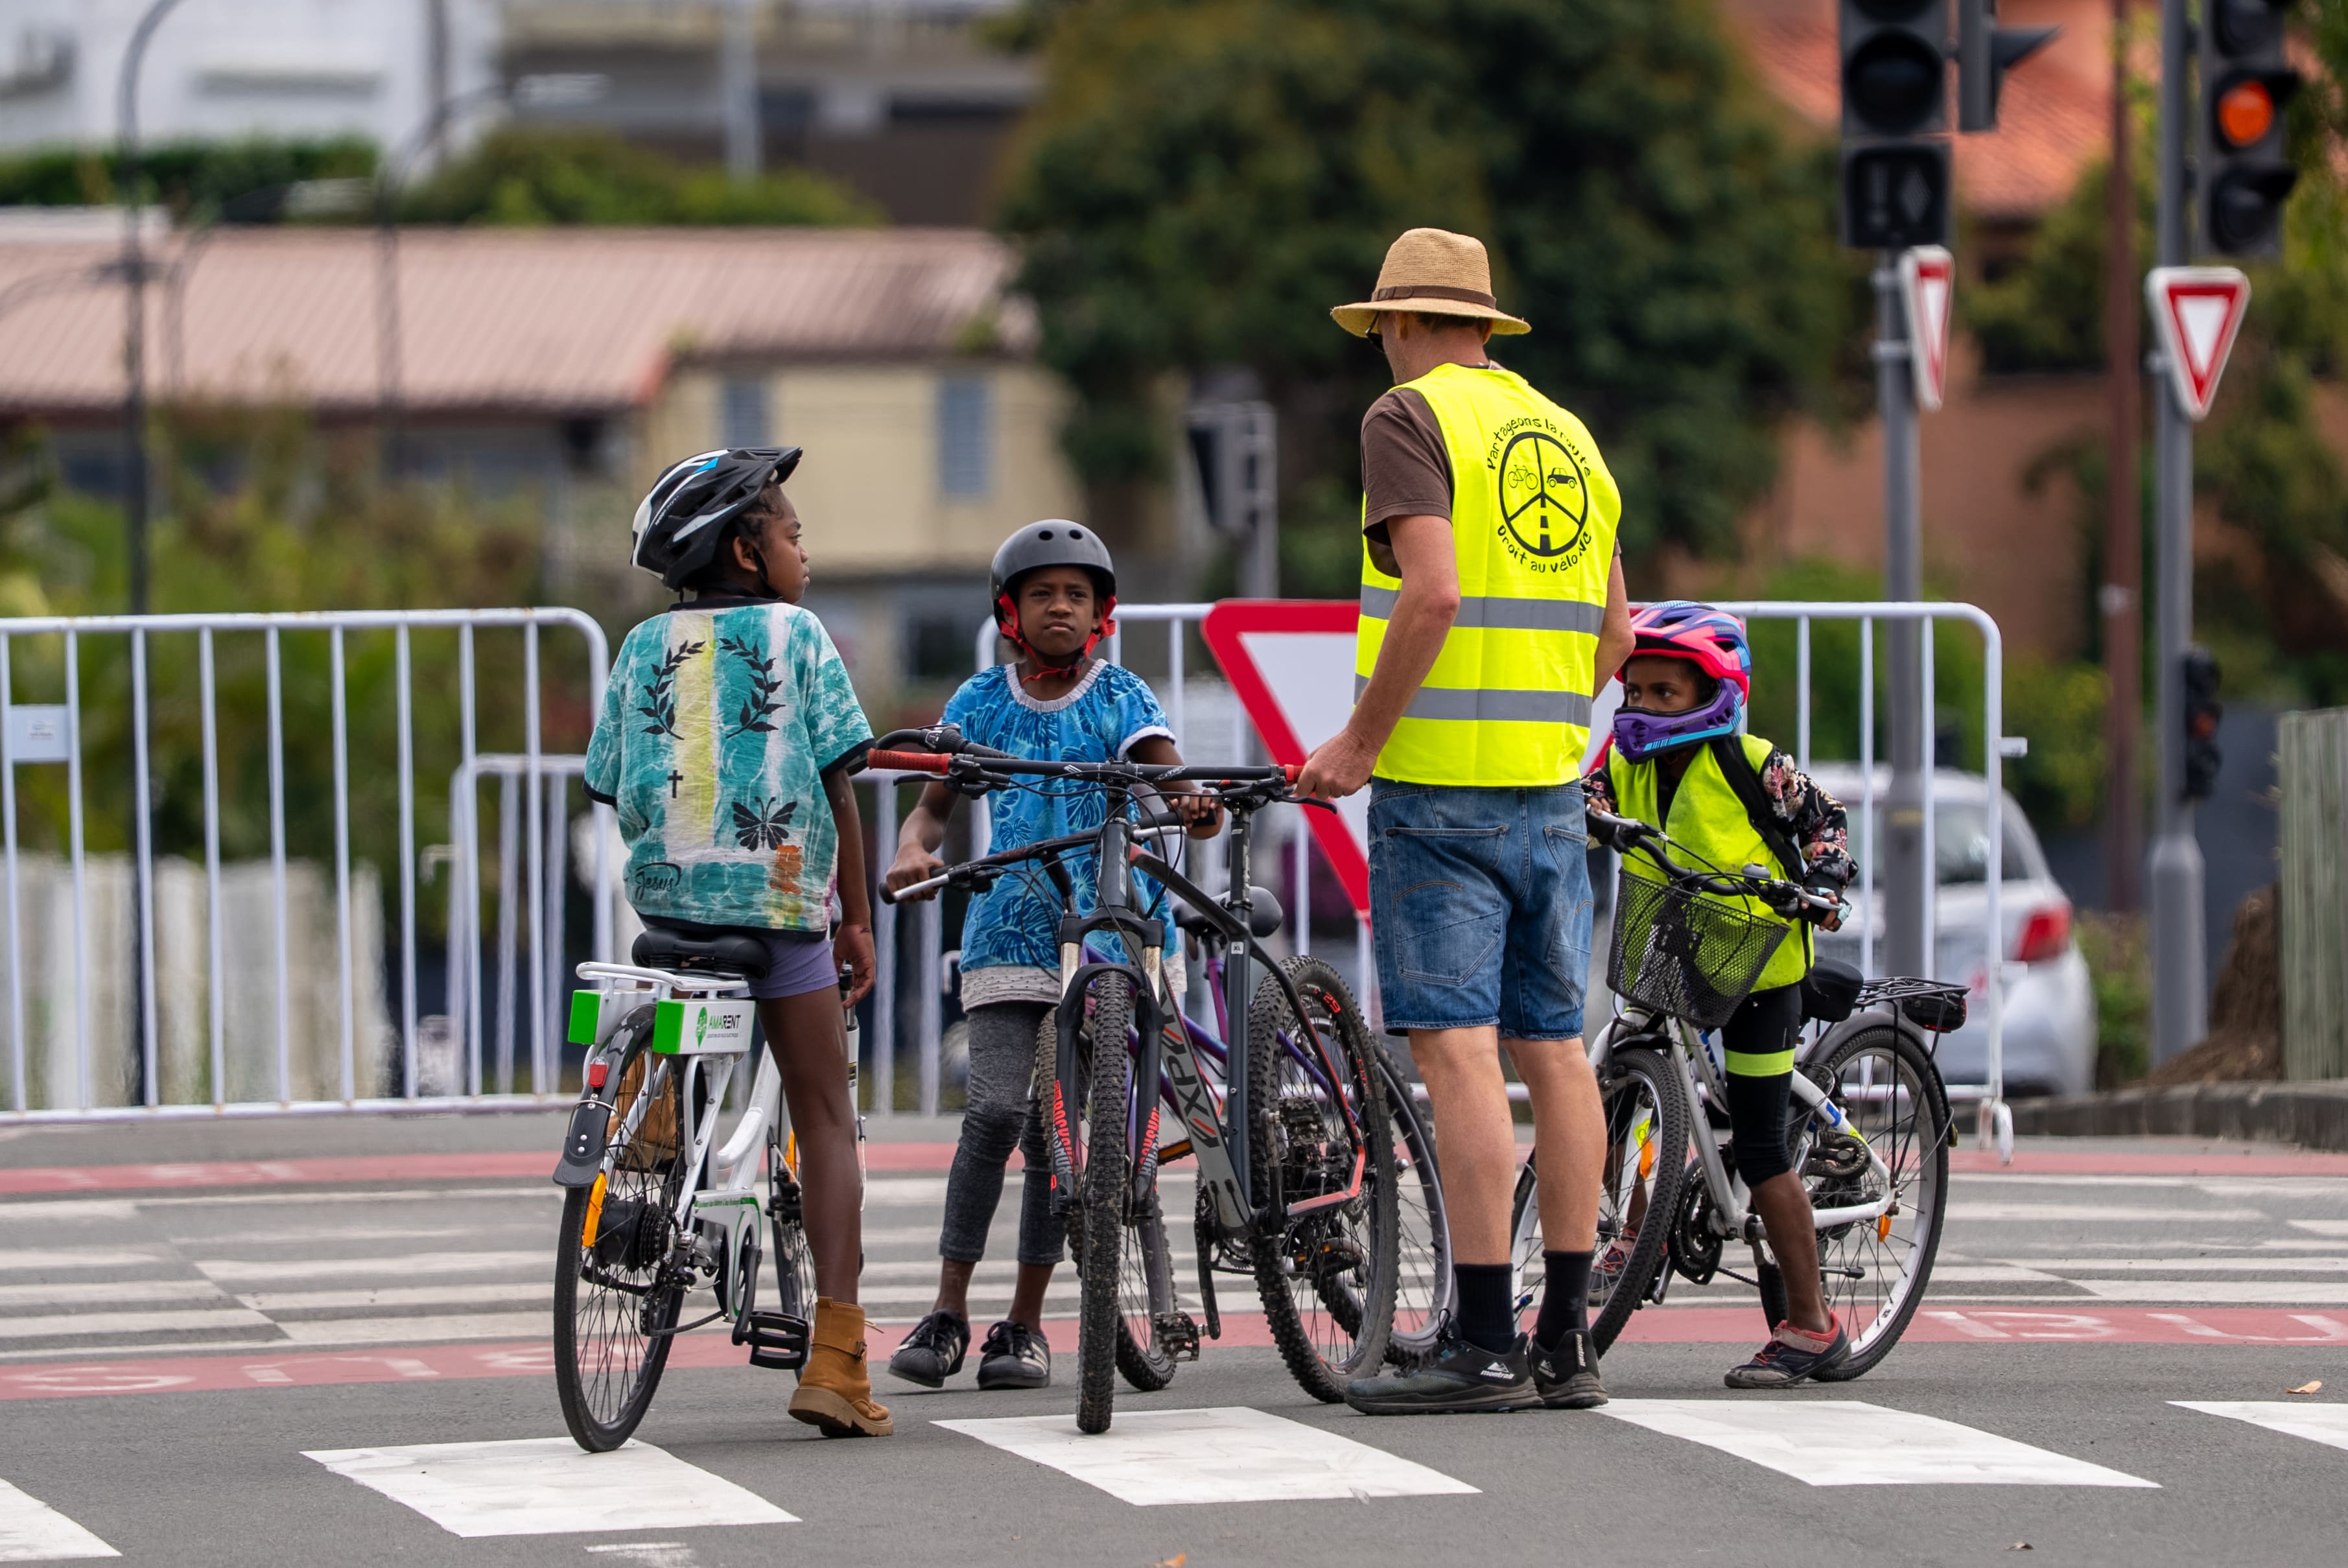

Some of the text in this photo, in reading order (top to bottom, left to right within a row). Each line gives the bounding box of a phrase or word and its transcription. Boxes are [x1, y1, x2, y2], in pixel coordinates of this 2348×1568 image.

[1487, 417, 1591, 478] Partageons la route
[1497, 525, 1528, 565] Droit
[1531, 560, 1546, 572] au
[1551, 554, 1578, 573] vélo
[635, 869, 674, 901] Jesus
[709, 1014, 741, 1029] AMARENT
[1480, 1370, 1515, 1380] montrail
